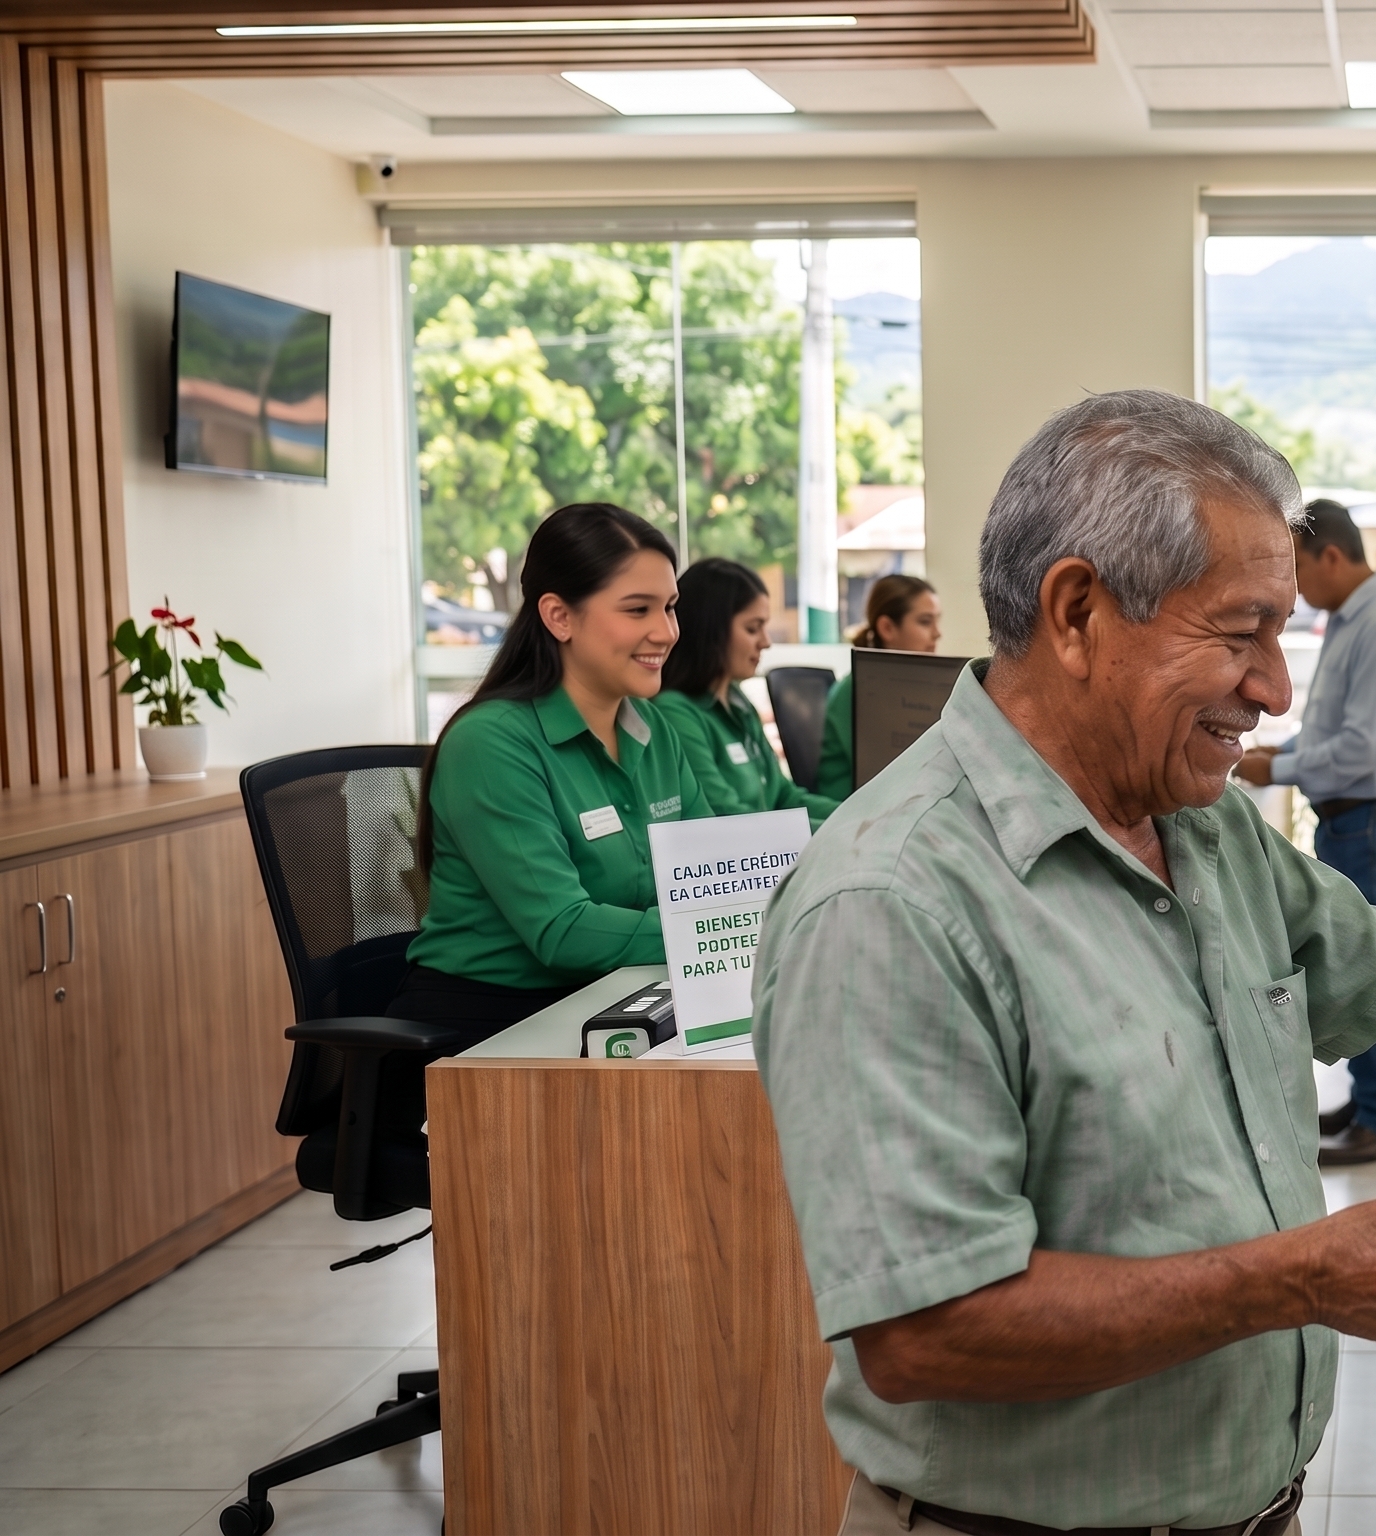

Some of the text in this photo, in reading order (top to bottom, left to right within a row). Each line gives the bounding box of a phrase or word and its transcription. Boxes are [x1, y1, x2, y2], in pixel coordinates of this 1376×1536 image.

[673, 863, 713, 880] CAJA
[716, 860, 737, 876] DE
[683, 958, 728, 978] PARA
